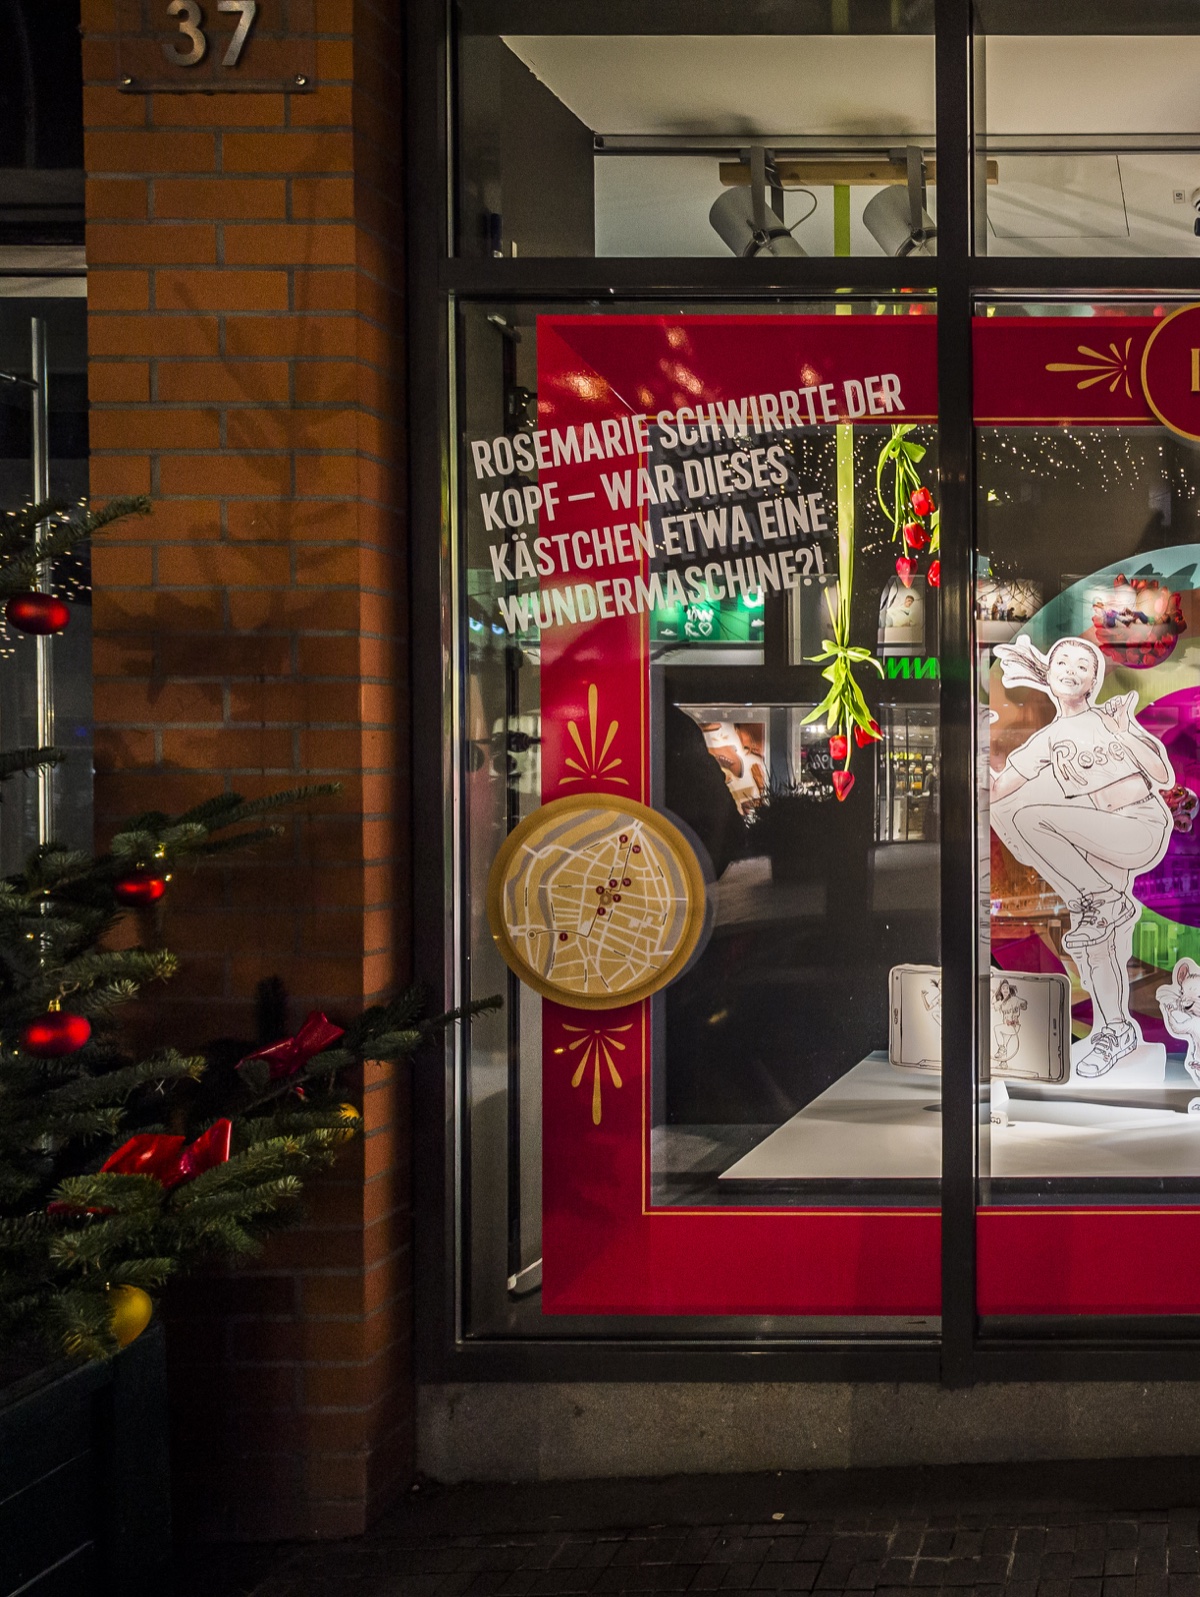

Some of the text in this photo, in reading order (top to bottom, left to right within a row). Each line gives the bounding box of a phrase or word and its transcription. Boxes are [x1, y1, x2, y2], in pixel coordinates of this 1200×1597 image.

[162, 0, 256, 67] 37
[471, 373, 906, 479] ROSEMARIE SCHWIRRTE DER
[480, 481, 561, 531] KOPF
[600, 461, 679, 511] WAR
[683, 445, 790, 499] DIESES
[489, 492, 830, 583] KÄSTCHEN ETWA EINE
[497, 546, 828, 636] WUNDERMASCHINE?!
[1052, 739, 1125, 787] Rose
